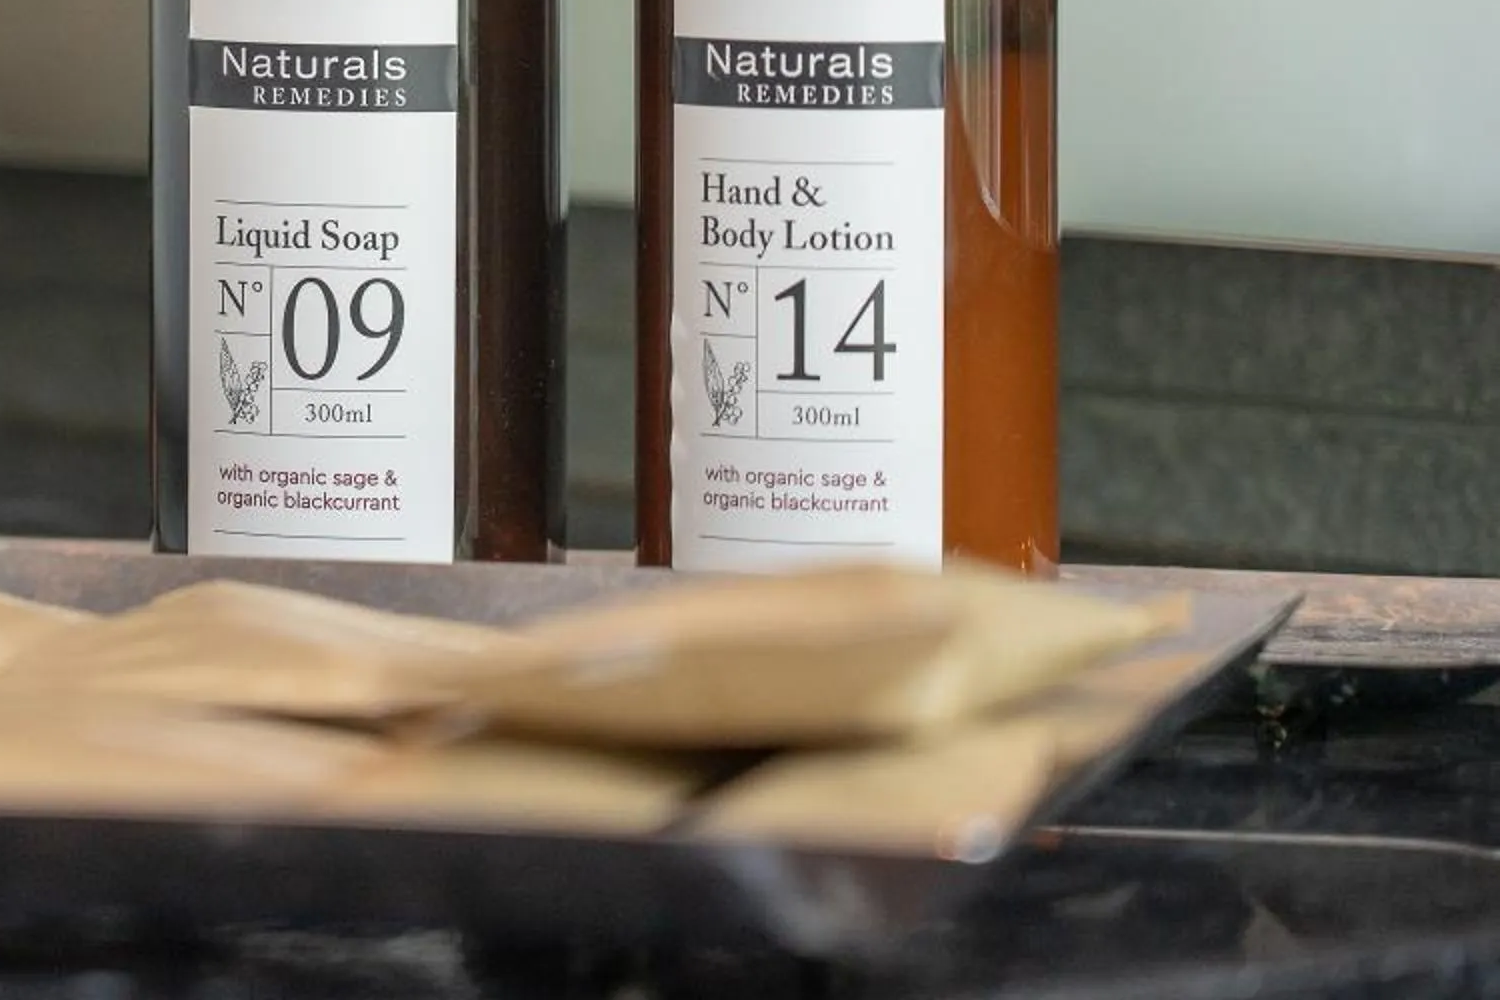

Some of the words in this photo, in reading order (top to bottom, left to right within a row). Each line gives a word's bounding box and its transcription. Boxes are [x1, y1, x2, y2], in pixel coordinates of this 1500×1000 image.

[222, 45, 407, 80] Naturals
[706, 43, 893, 79] Naturals
[253, 85, 407, 107] REMEDIES
[737, 83, 894, 105] REMEDIES
[701, 172, 782, 206] Hand
[791, 176, 827, 207] &
[216, 216, 311, 258] Liquid
[321, 220, 399, 260] Soap
[701, 216, 774, 259] Body
[784, 220, 894, 251] Lotion
[282, 277, 405, 381] 09
[775, 278, 897, 381] 14
[305, 403, 372, 423] 300ml
[792, 406, 860, 426] 300ml
[219, 463, 253, 482] with
[259, 467, 327, 487] organic
[333, 470, 379, 489] sage
[384, 470, 397, 486] &
[705, 465, 740, 482] with
[745, 468, 815, 489] organic
[821, 472, 867, 490] sage
[873, 471, 886, 487] &
[217, 489, 278, 509] organic
[284, 492, 400, 511] blackcurrant
[703, 491, 765, 510] organic
[771, 493, 889, 512] blackcurrant
